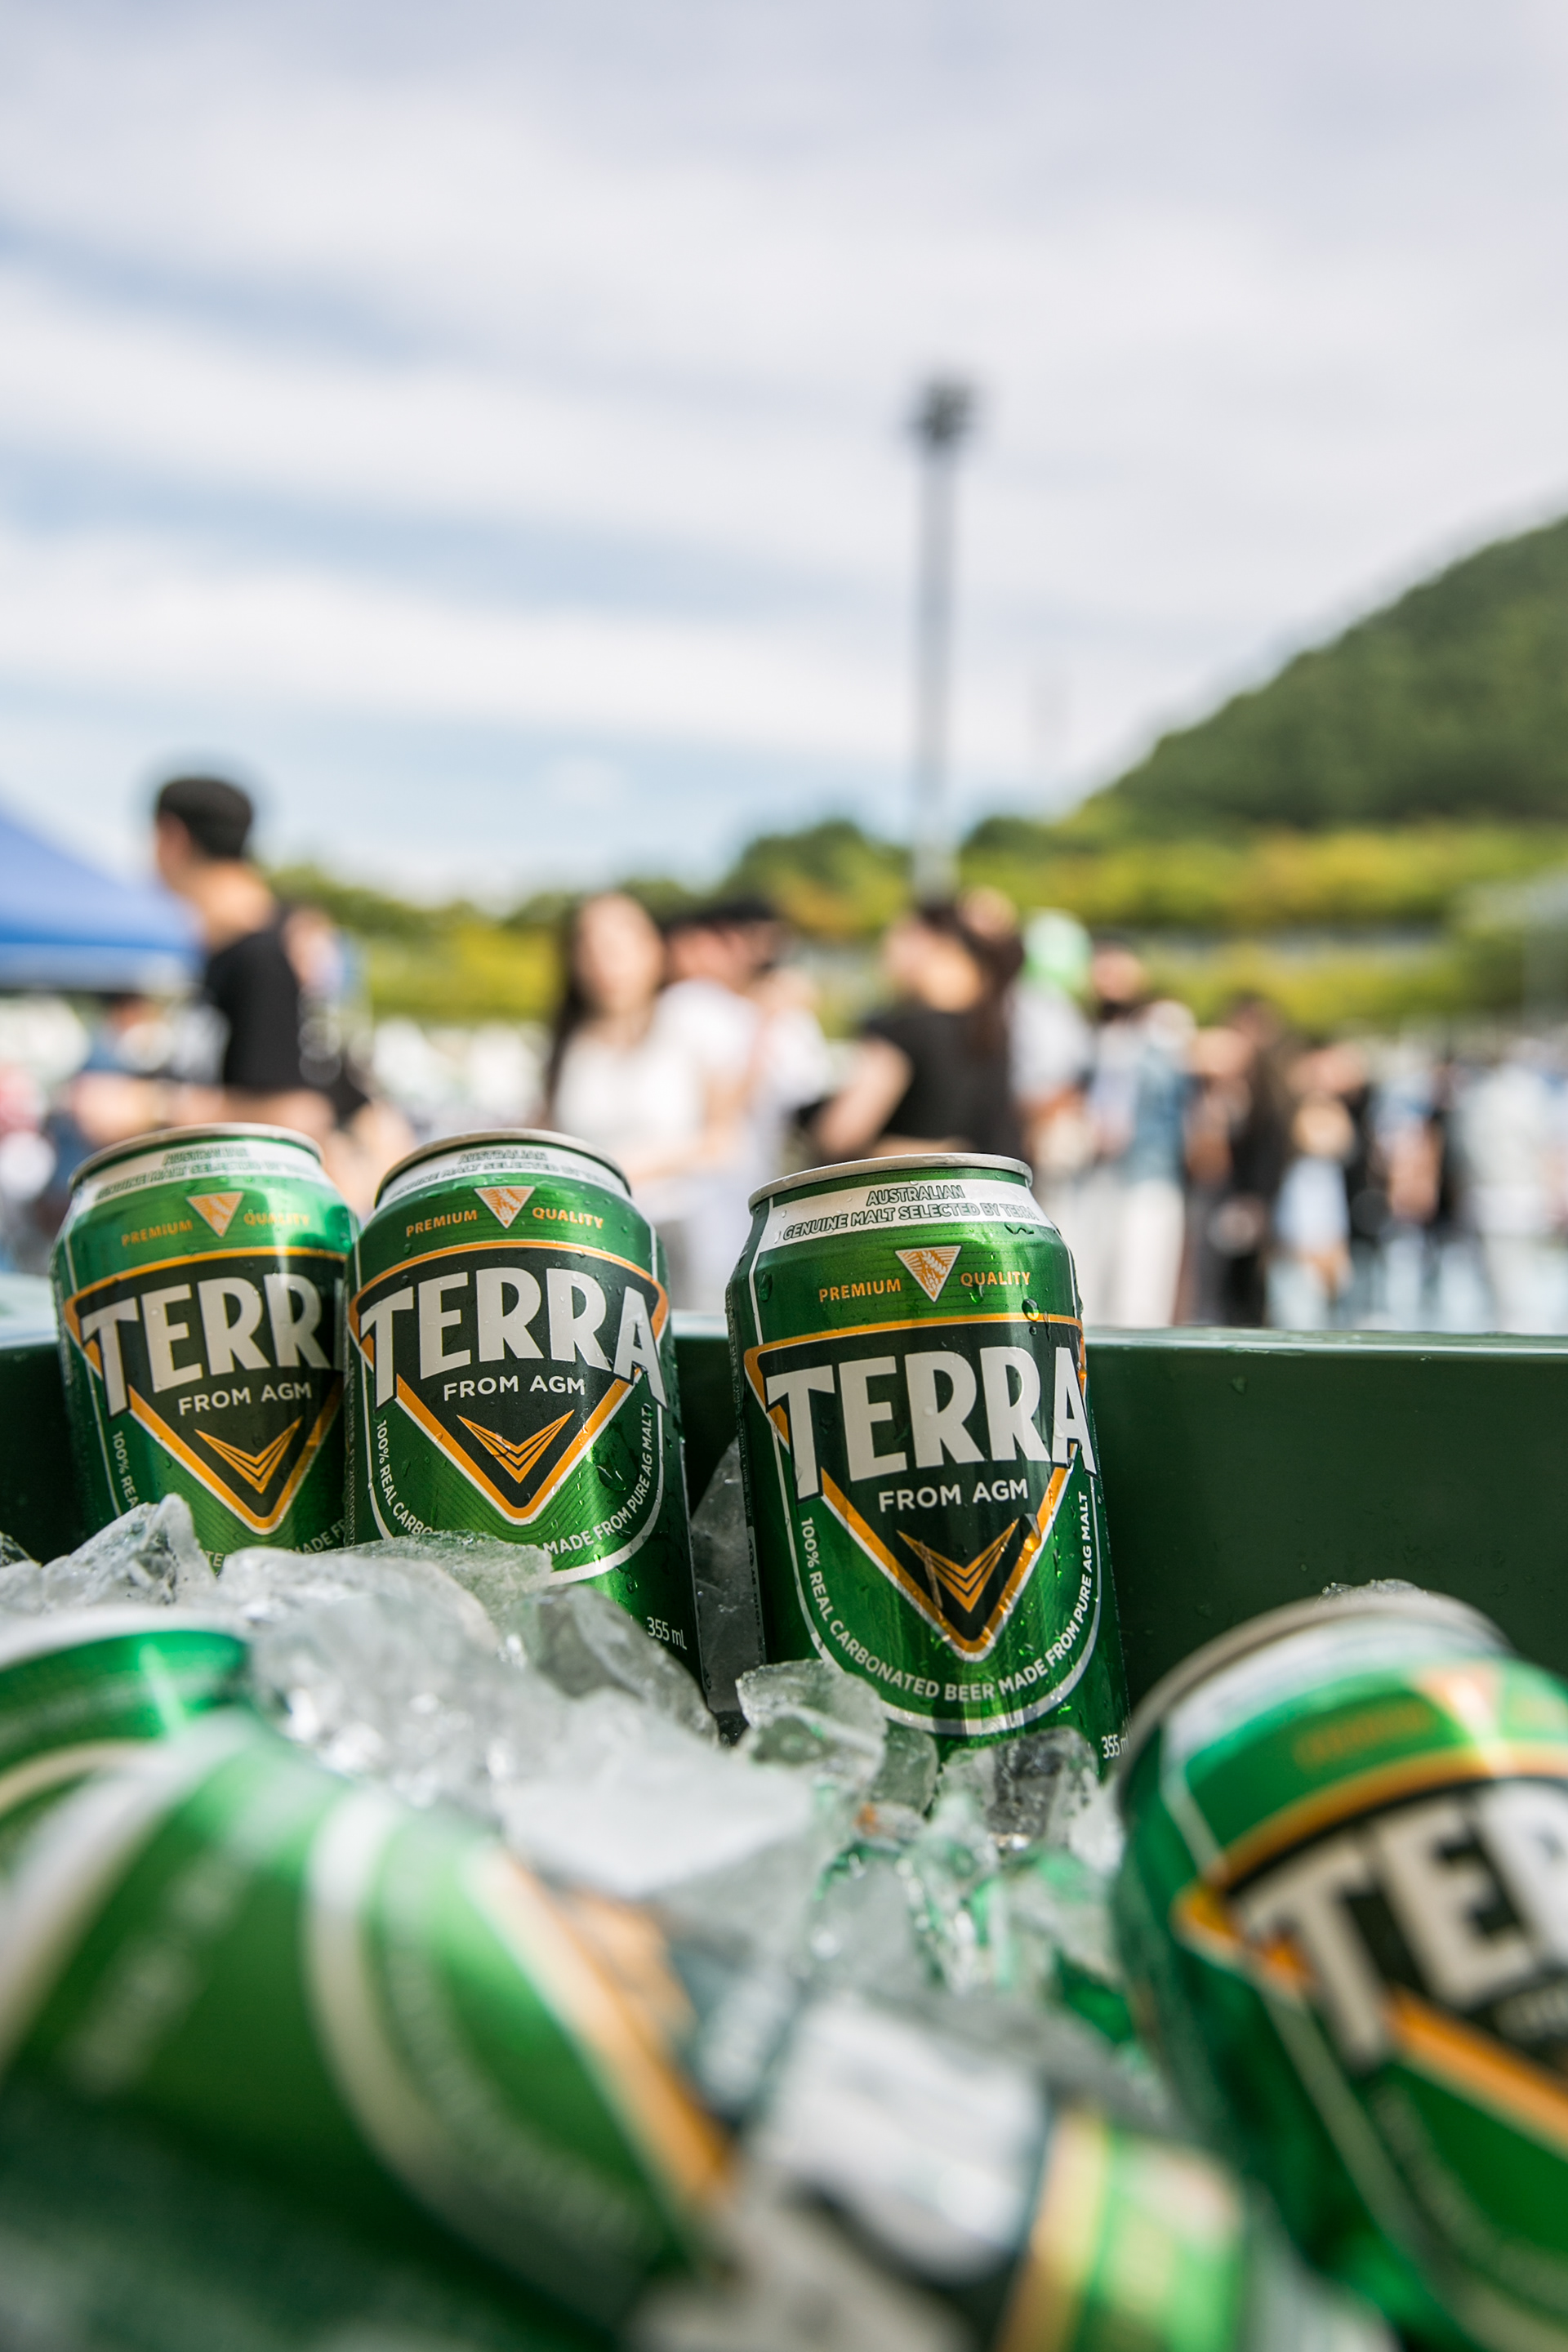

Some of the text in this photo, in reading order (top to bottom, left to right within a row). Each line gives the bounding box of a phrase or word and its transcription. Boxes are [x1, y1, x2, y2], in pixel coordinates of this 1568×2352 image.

[457, 1149, 548, 1165] AUSTRALIAN
[866, 1185, 965, 1206] AUSTRALIAN
[122, 1211, 310, 1246] PREMIUM QUALITY
[406, 1206, 604, 1237] PREMIUM QUALITY
[782, 1202, 1040, 1241] GENUINE MALT SELECTED BY TERRA
[818, 1271, 1031, 1303] PREMIUM QUALITY
[80, 1273, 345, 1418] TERR
[360, 1267, 667, 1410] TERRA
[178, 1382, 312, 1416] FROM AGM
[443, 1374, 586, 1401] FROM AGM
[766, 1346, 1098, 1501] TERRA
[112, 1430, 140, 1509] 100% REA
[376, 1419, 434, 1536] 100% REAL CARBO
[543, 1406, 653, 1555] MADE FROM PURE AG MALT
[879, 1478, 1029, 1513] FROM AGM
[800, 1490, 1093, 1702] 100% REAL CARBONATED BEER MADE FROM PURE AG MALT
[646, 1615, 688, 1650] 355 mL
[1101, 1734, 1120, 1759] 355
[1237, 1780, 1568, 2056] TER
